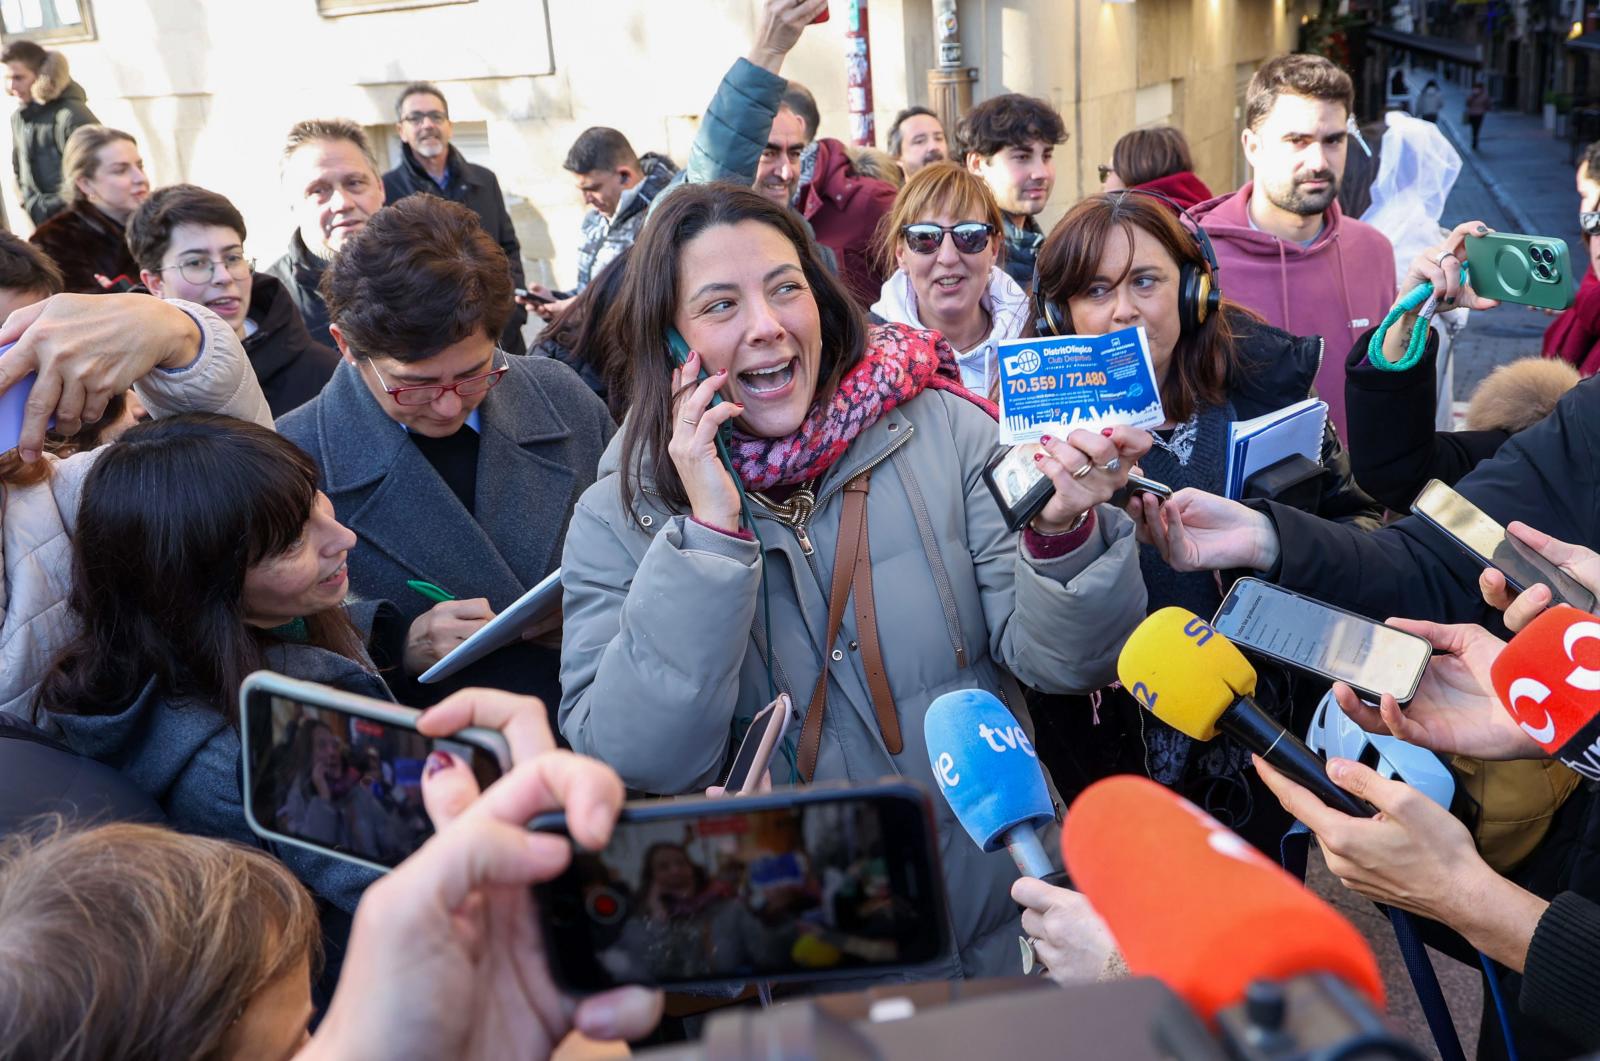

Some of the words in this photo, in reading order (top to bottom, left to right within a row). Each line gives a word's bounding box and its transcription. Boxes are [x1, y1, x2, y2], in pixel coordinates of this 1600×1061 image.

[1007, 375, 1056, 394] 70.559
[1066, 371, 1107, 388] 72.480
[979, 723, 1036, 757] tve
[932, 752, 960, 788] ve
